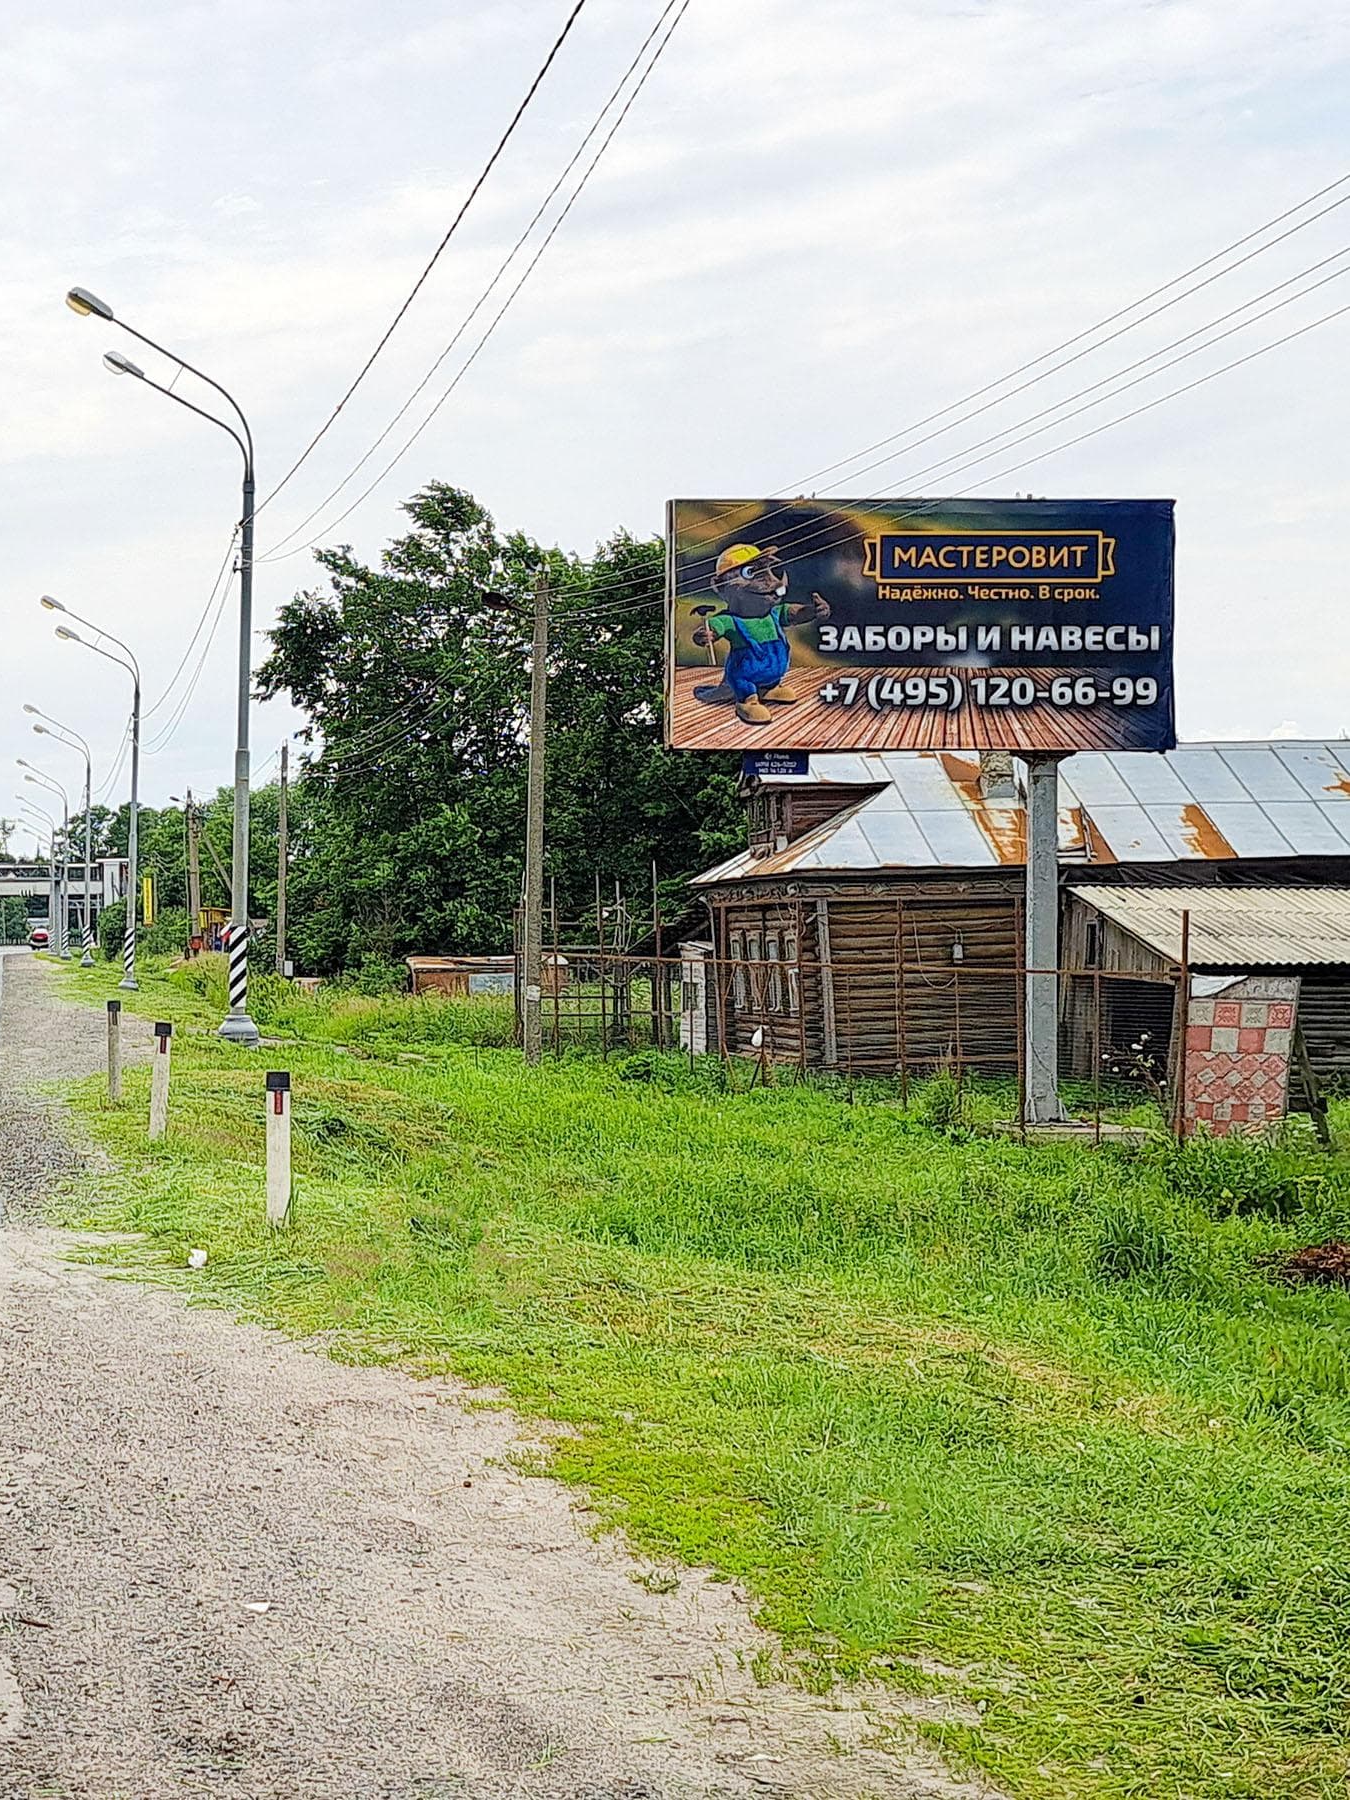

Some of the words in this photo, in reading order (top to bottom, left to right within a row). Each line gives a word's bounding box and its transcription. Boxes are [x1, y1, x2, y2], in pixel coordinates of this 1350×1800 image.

[893, 545, 1089, 569] МАСТЕРОВИТ
[878, 584, 964, 602] Надёжно.
[967, 584, 1035, 600] Честно.
[1038, 584, 1050, 600] В
[1054, 586, 1100, 603] срок.
[818, 625, 968, 651] ЗАБОРЫ
[977, 625, 1001, 651] И
[1010, 625, 1161, 651] НАВЕСЫ
[819, 676, 860, 706] +7
[867, 673, 963, 711] (495)
[970, 676, 1158, 706] 120-66-99
